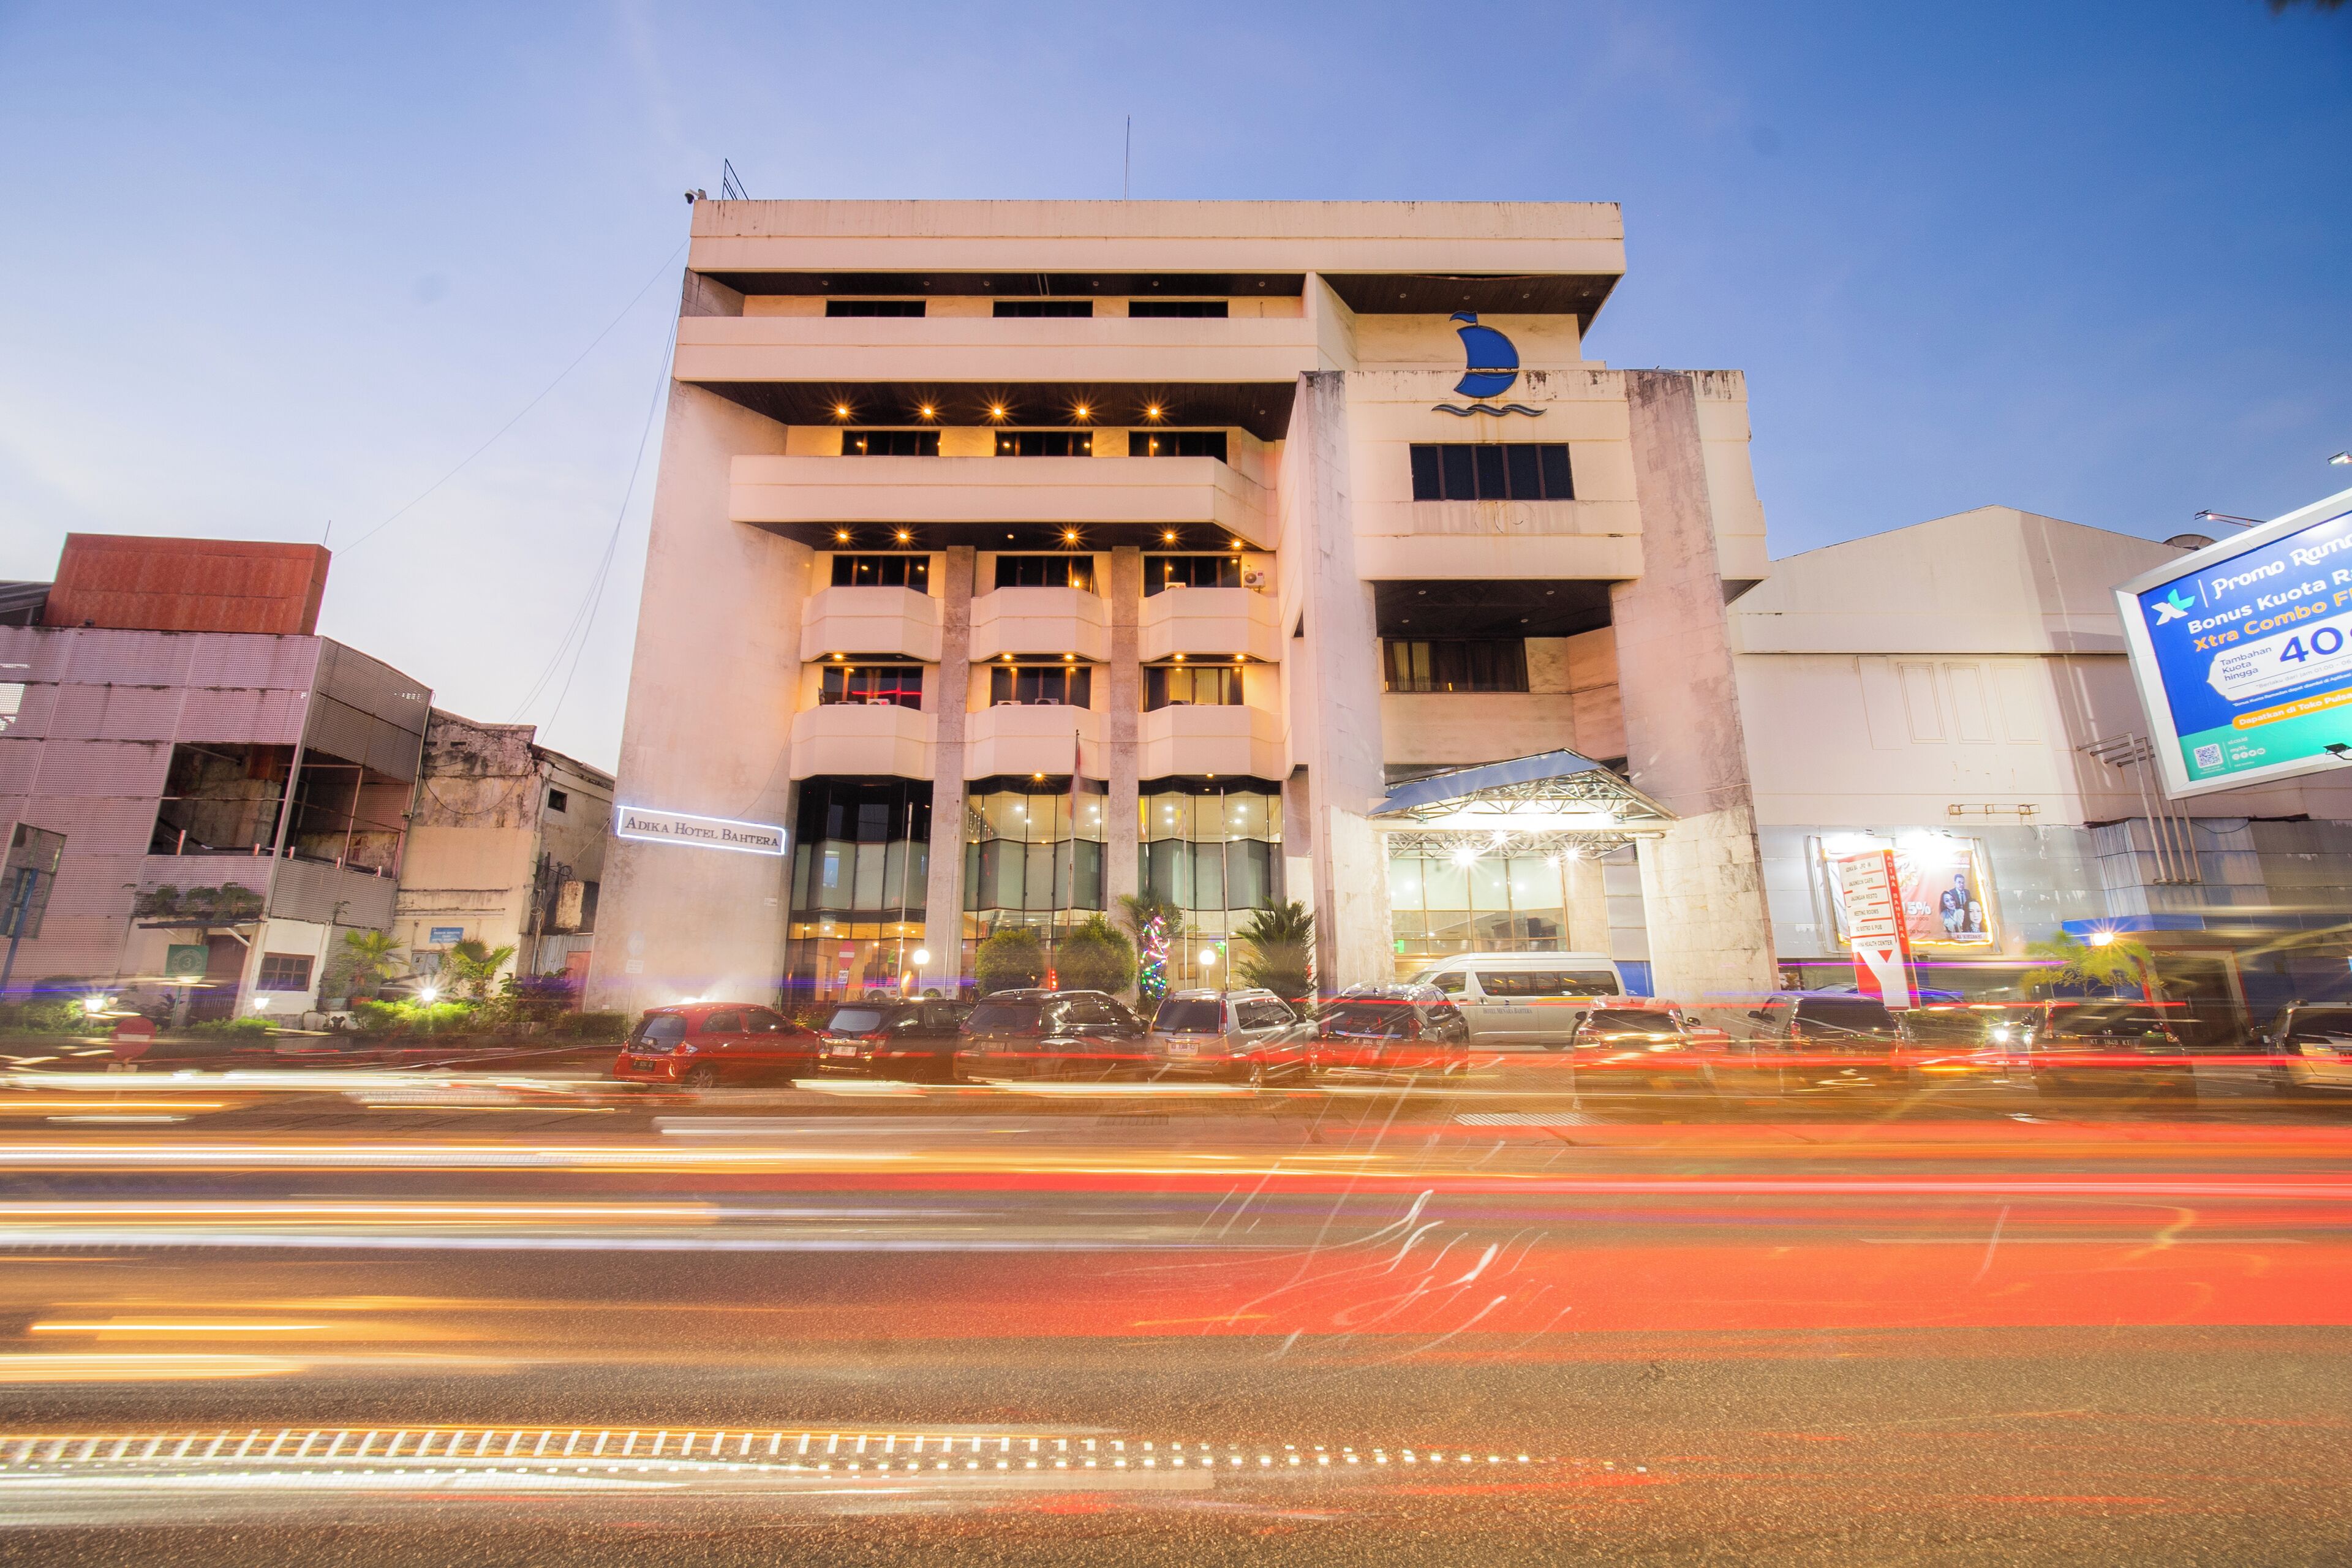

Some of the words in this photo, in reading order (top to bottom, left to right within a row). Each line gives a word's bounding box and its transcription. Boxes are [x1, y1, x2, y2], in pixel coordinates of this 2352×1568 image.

[2211, 560, 2285, 600] Promo
[2187, 605, 2253, 635] Bonus
[2256, 579, 2327, 611] Kuota
[2332, 568, 2352, 586] R
[2193, 630, 2239, 652] Xtra
[2244, 601, 2327, 635] Combo
[2220, 646, 2272, 666] Tambahan
[2222, 661, 2252, 674] Kuota
[2224, 667, 2259, 682] hingga
[2239, 709, 2285, 726] Dapatkan
[2297, 700, 2323, 711] Toko
[625, 816, 669, 834] ADIKA
[673, 821, 718, 839] HOTEL
[722, 828, 779, 846] BAHTERA
